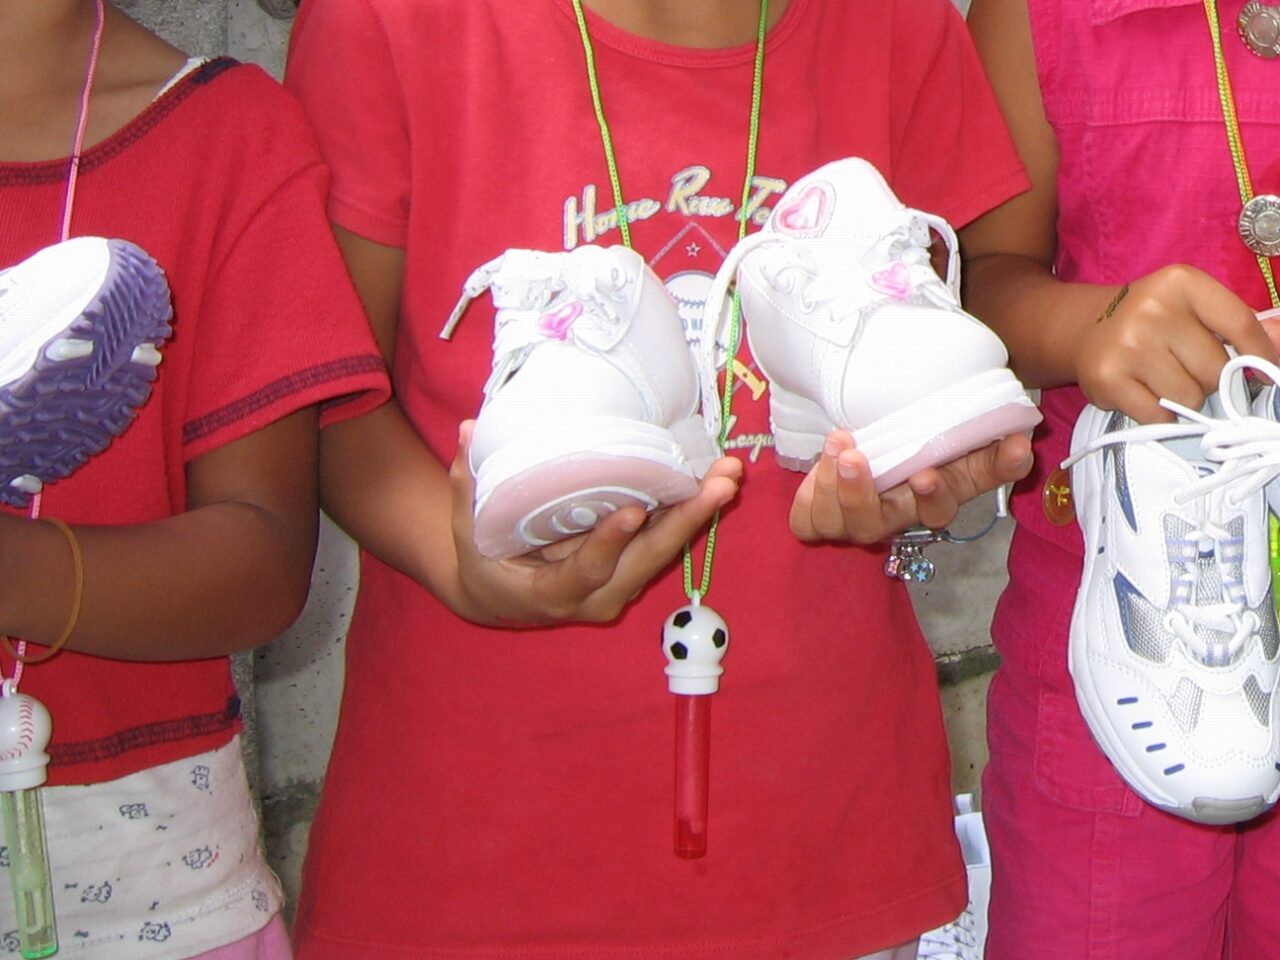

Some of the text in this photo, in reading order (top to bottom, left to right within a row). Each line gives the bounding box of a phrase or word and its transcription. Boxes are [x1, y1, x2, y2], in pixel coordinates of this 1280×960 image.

[564, 165, 788, 249] Home Run Te
[722, 414, 776, 463] Leagu
